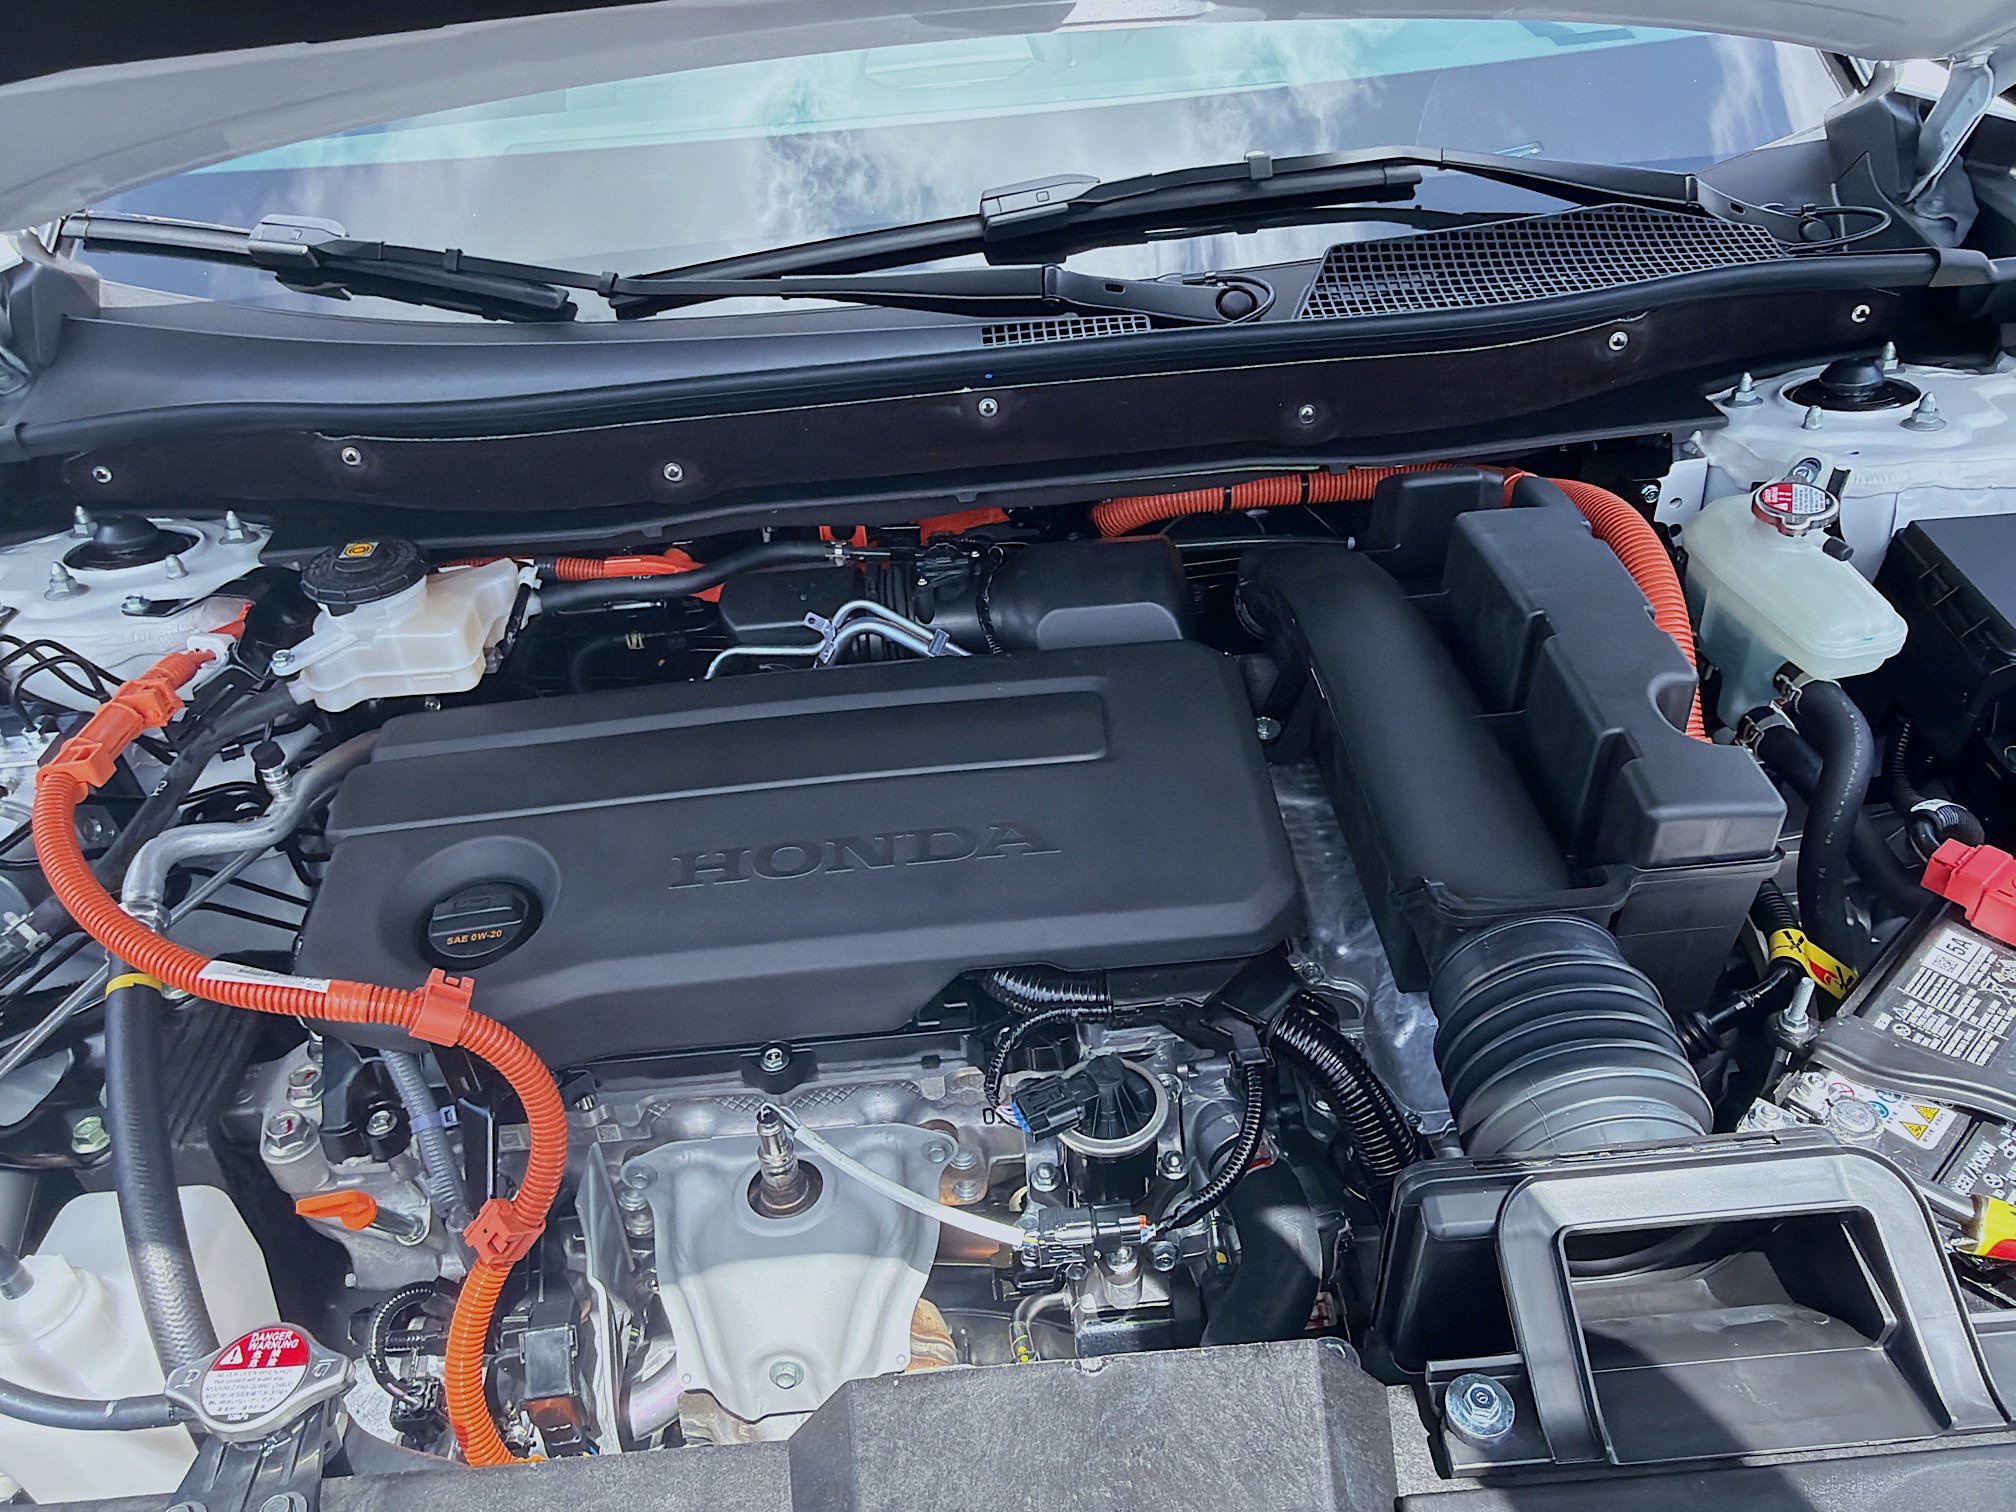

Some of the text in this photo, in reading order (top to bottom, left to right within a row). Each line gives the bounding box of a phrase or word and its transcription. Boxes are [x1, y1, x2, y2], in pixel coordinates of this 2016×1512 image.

[667, 821, 1062, 889] HONDA
[446, 929, 503, 946] SAE 0W-20
[1946, 937, 1972, 956] 5A
[250, 1330, 294, 1342] DANGER
[247, 1338, 300, 1352] WARNUNG
